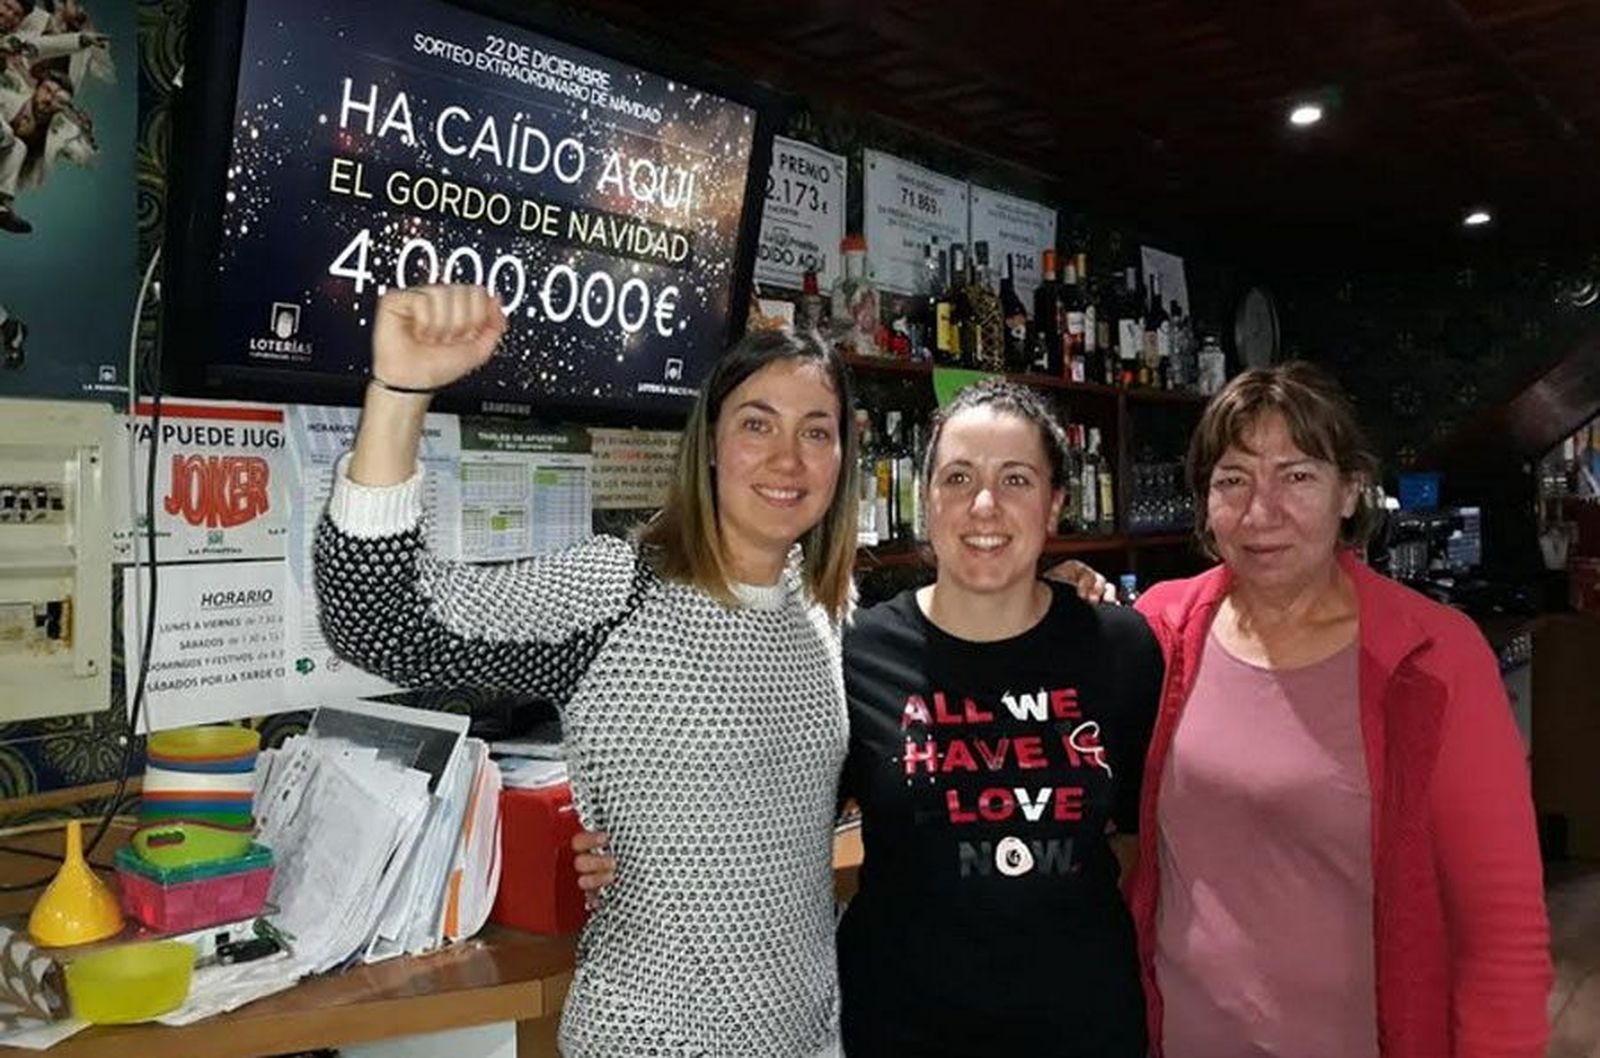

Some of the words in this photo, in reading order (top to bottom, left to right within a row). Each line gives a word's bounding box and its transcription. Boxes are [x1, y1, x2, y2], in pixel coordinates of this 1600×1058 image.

[413, 33, 474, 66] SORTEO
[475, 55, 590, 102] EXTRAORDINARIO
[590, 89, 609, 108] DE
[609, 96, 663, 123] NAVIDAD
[485, 35, 504, 56] 22
[506, 42, 531, 64] DE
[532, 49, 611, 91] DICIEMBRE
[340, 77, 415, 146] HA
[436, 106, 585, 183] CAÍDO
[780, 152, 830, 183] PREMIO
[330, 158, 373, 199] EL
[386, 170, 512, 225] GORDO
[520, 200, 562, 236] DE
[568, 210, 688, 262] NAVIDAD
[163, 425, 235, 446] PUEDE
[164, 454, 270, 528] JOKER
[201, 589, 273, 607] HORARIO
[203, 617, 241, 629] VIERNES
[200, 675, 223, 686] POR
[225, 672, 238, 683] LA
[241, 669, 272, 680] TARDE
[900, 691, 993, 729] ALL
[1001, 687, 1082, 722] WE
[903, 735, 1049, 776] HAVE
[946, 787, 1084, 823] LOVE
